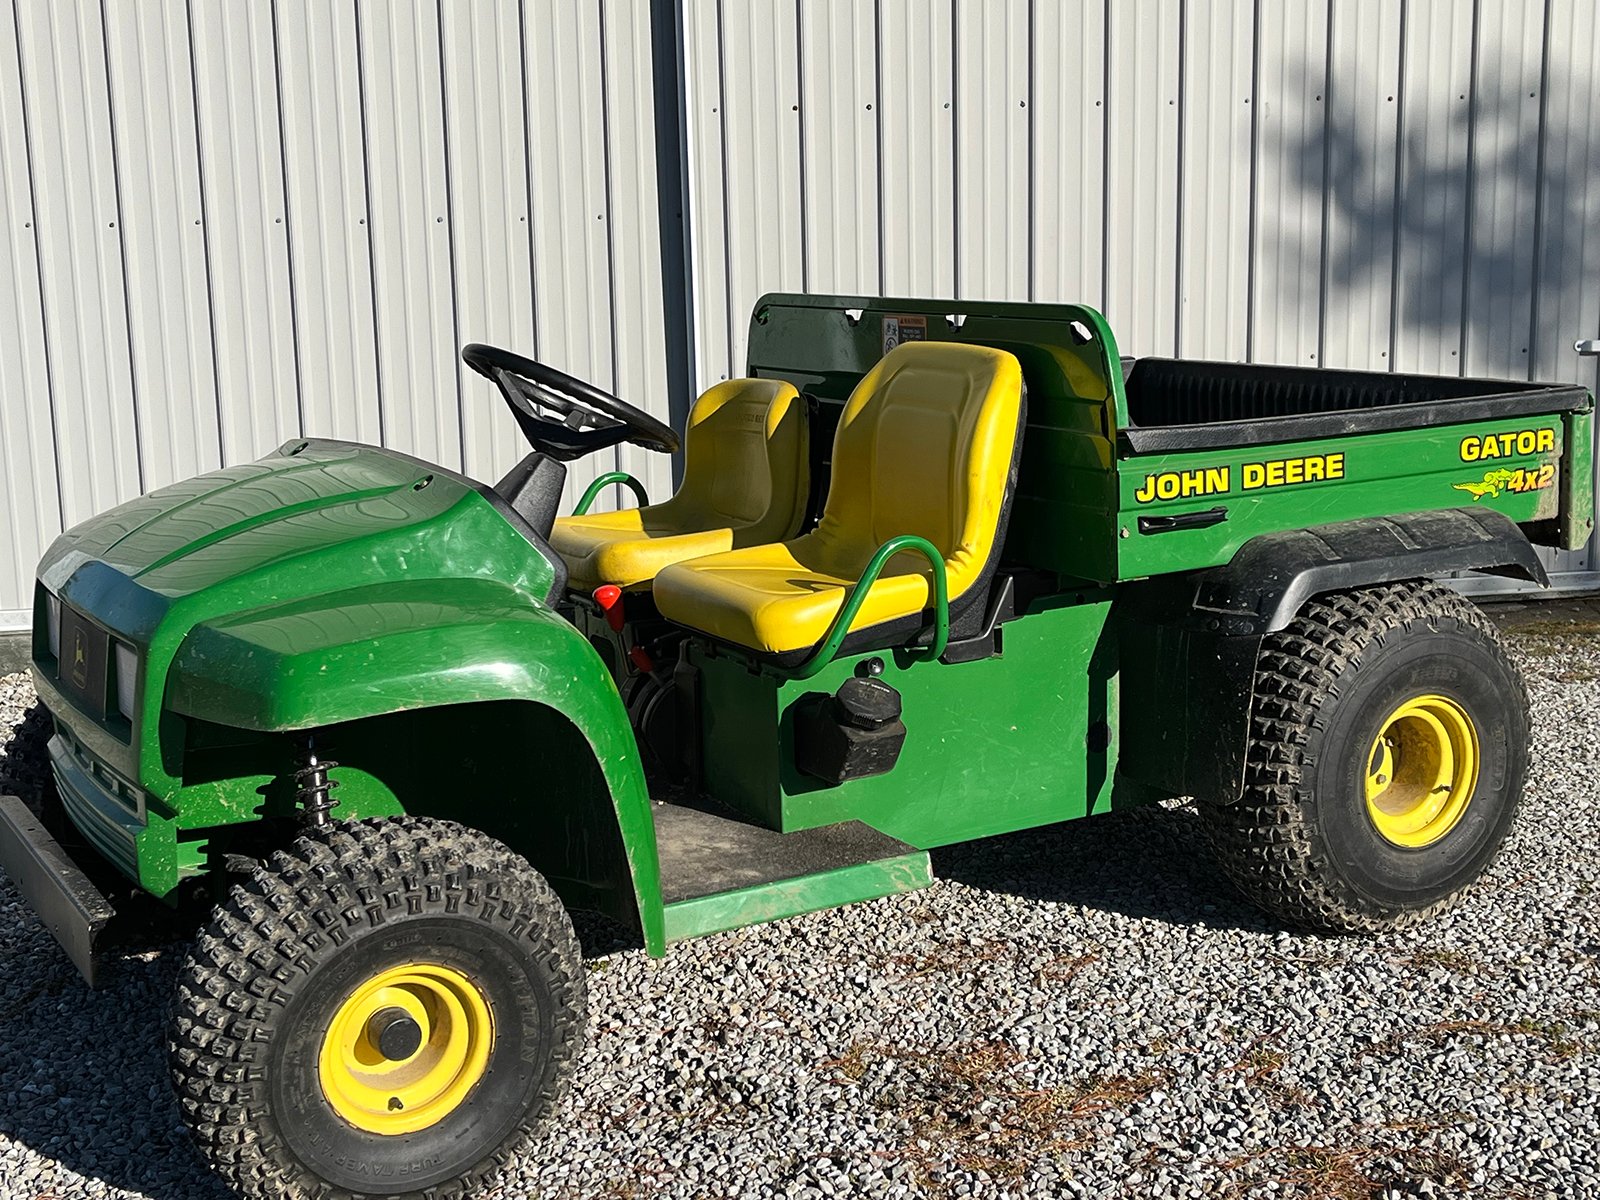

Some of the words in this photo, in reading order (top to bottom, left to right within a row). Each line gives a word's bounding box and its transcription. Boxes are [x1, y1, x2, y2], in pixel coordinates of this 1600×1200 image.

[1460, 428, 1555, 462] GATOR
[1135, 466, 1230, 503] JOHN
[1241, 452, 1345, 491] DEERE
[1506, 464, 1555, 494] 4x2
[335, 1155, 395, 1177] TAMER
[400, 1154, 445, 1175] TURF
